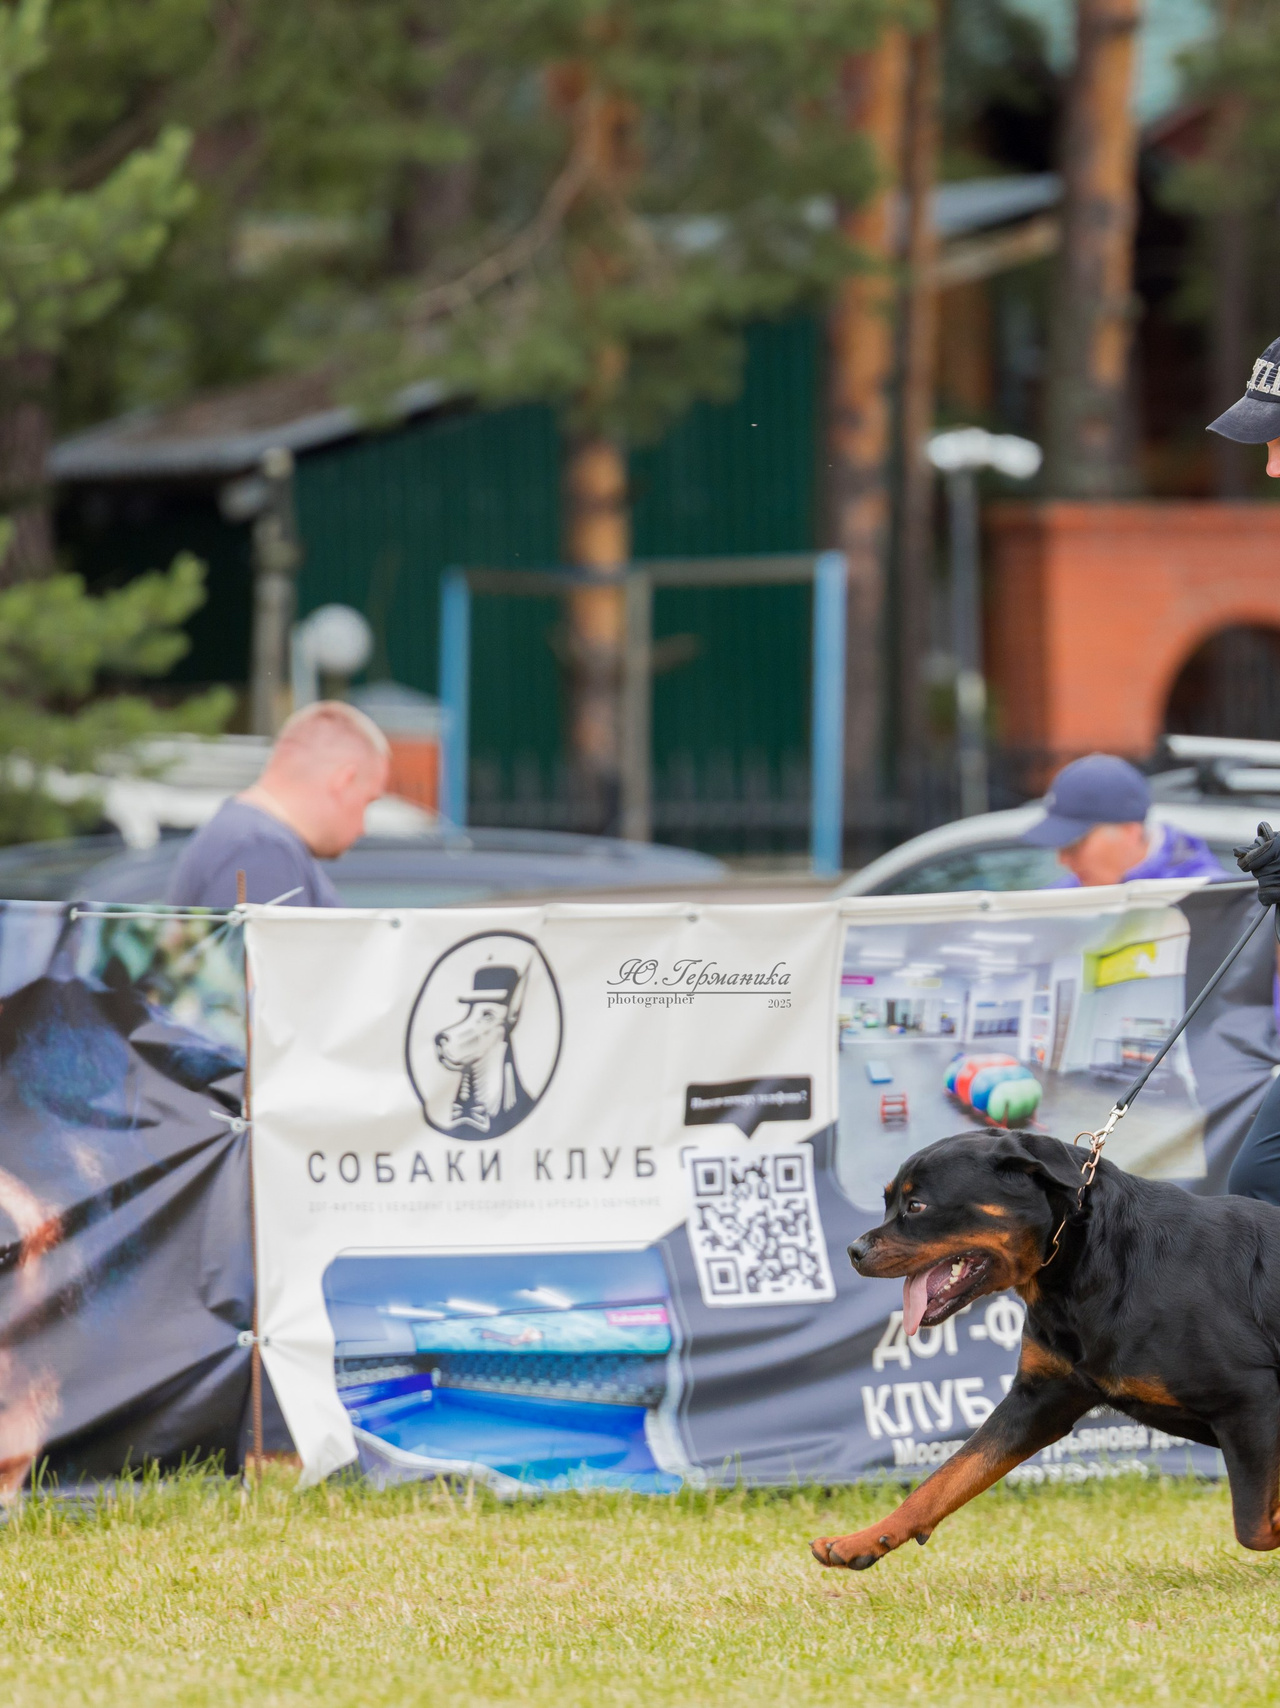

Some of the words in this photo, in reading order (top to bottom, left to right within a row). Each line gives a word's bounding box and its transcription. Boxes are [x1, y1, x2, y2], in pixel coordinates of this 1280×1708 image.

[307, 1149, 502, 1183] СОБАКИ
[535, 1145, 657, 1181] КЛУБ
[872, 1295, 1026, 1372] ДОГ-Ф
[861, 1376, 996, 1440] КЛУБ
